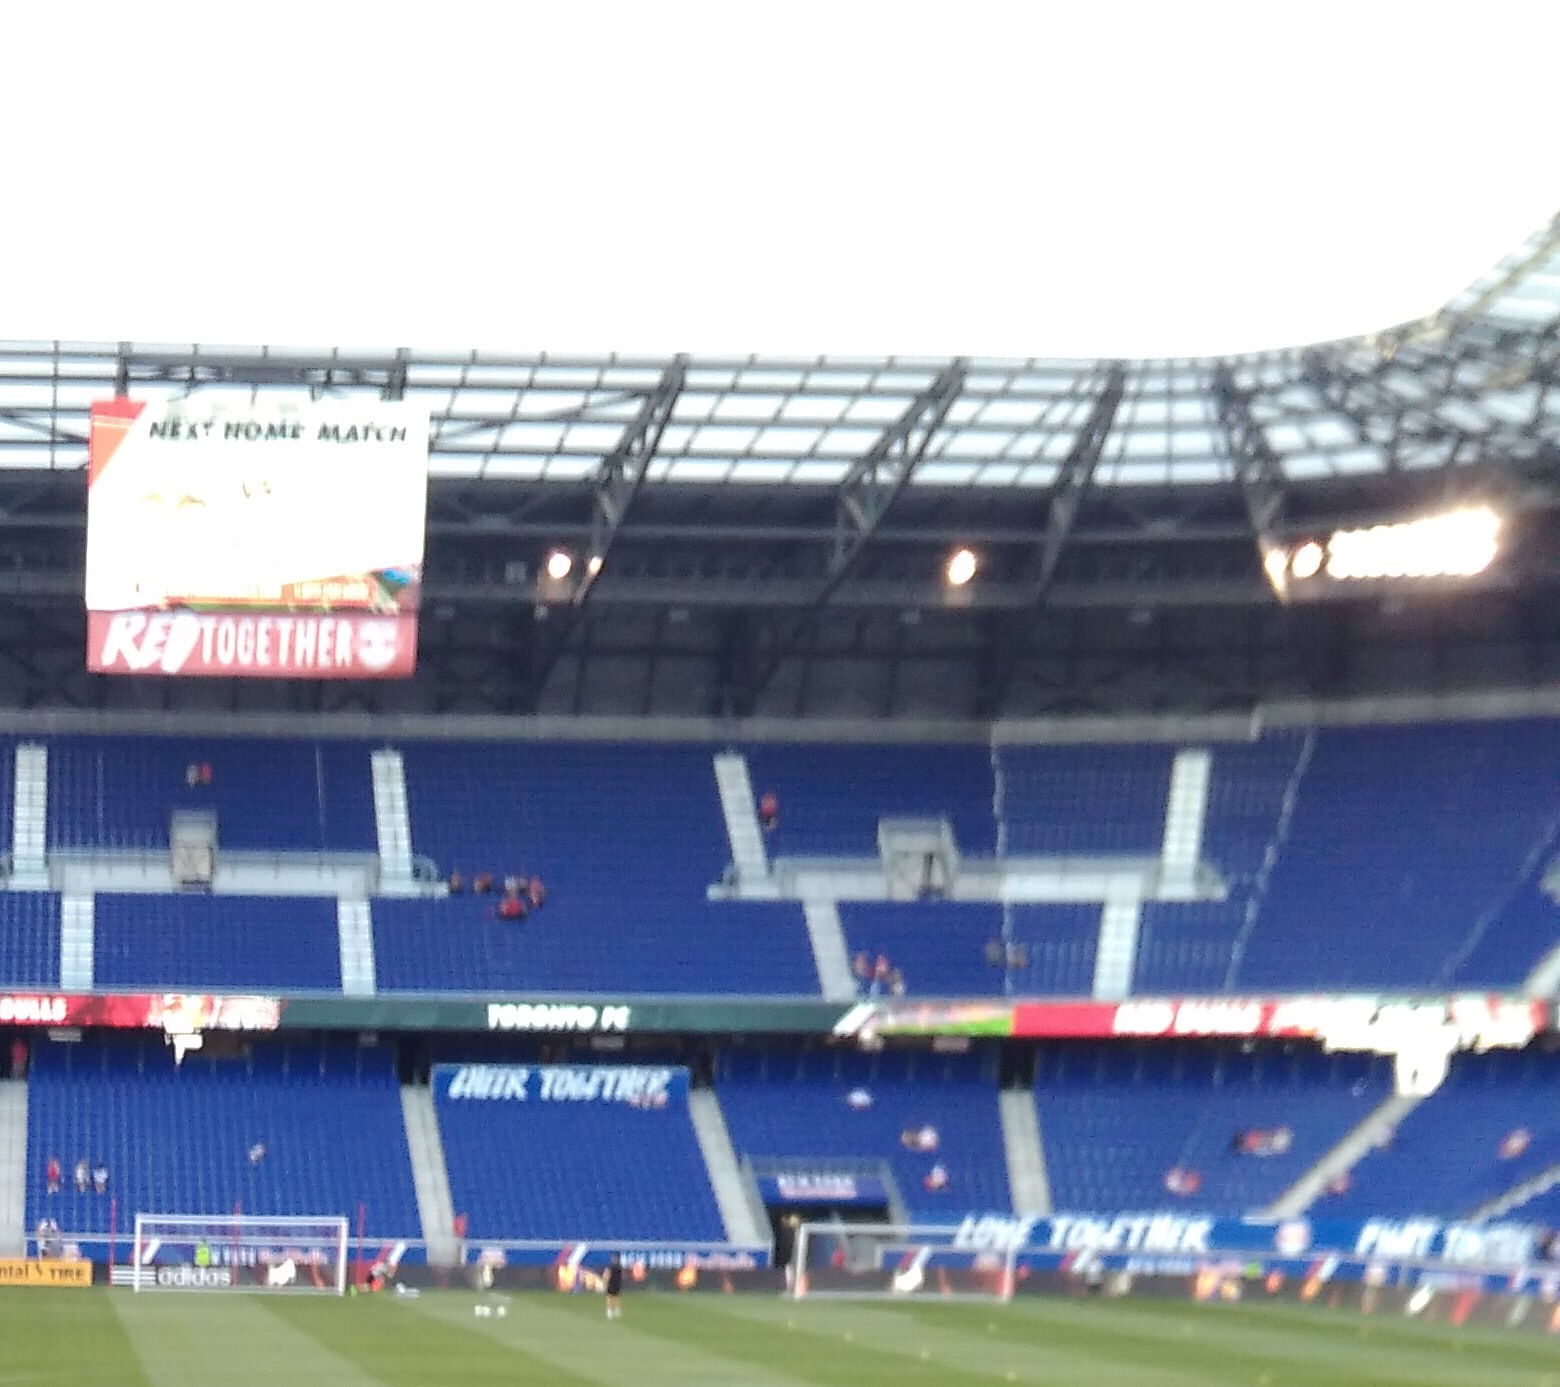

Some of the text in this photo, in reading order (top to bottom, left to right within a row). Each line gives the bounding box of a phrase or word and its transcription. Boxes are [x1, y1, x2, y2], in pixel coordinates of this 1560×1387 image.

[149, 420, 407, 444] NEXT HOME MATCH
[101, 614, 354, 674] RED TOGETHER
[49, 1268, 86, 1281] TIRE
[158, 1262, 232, 1287] adidas
